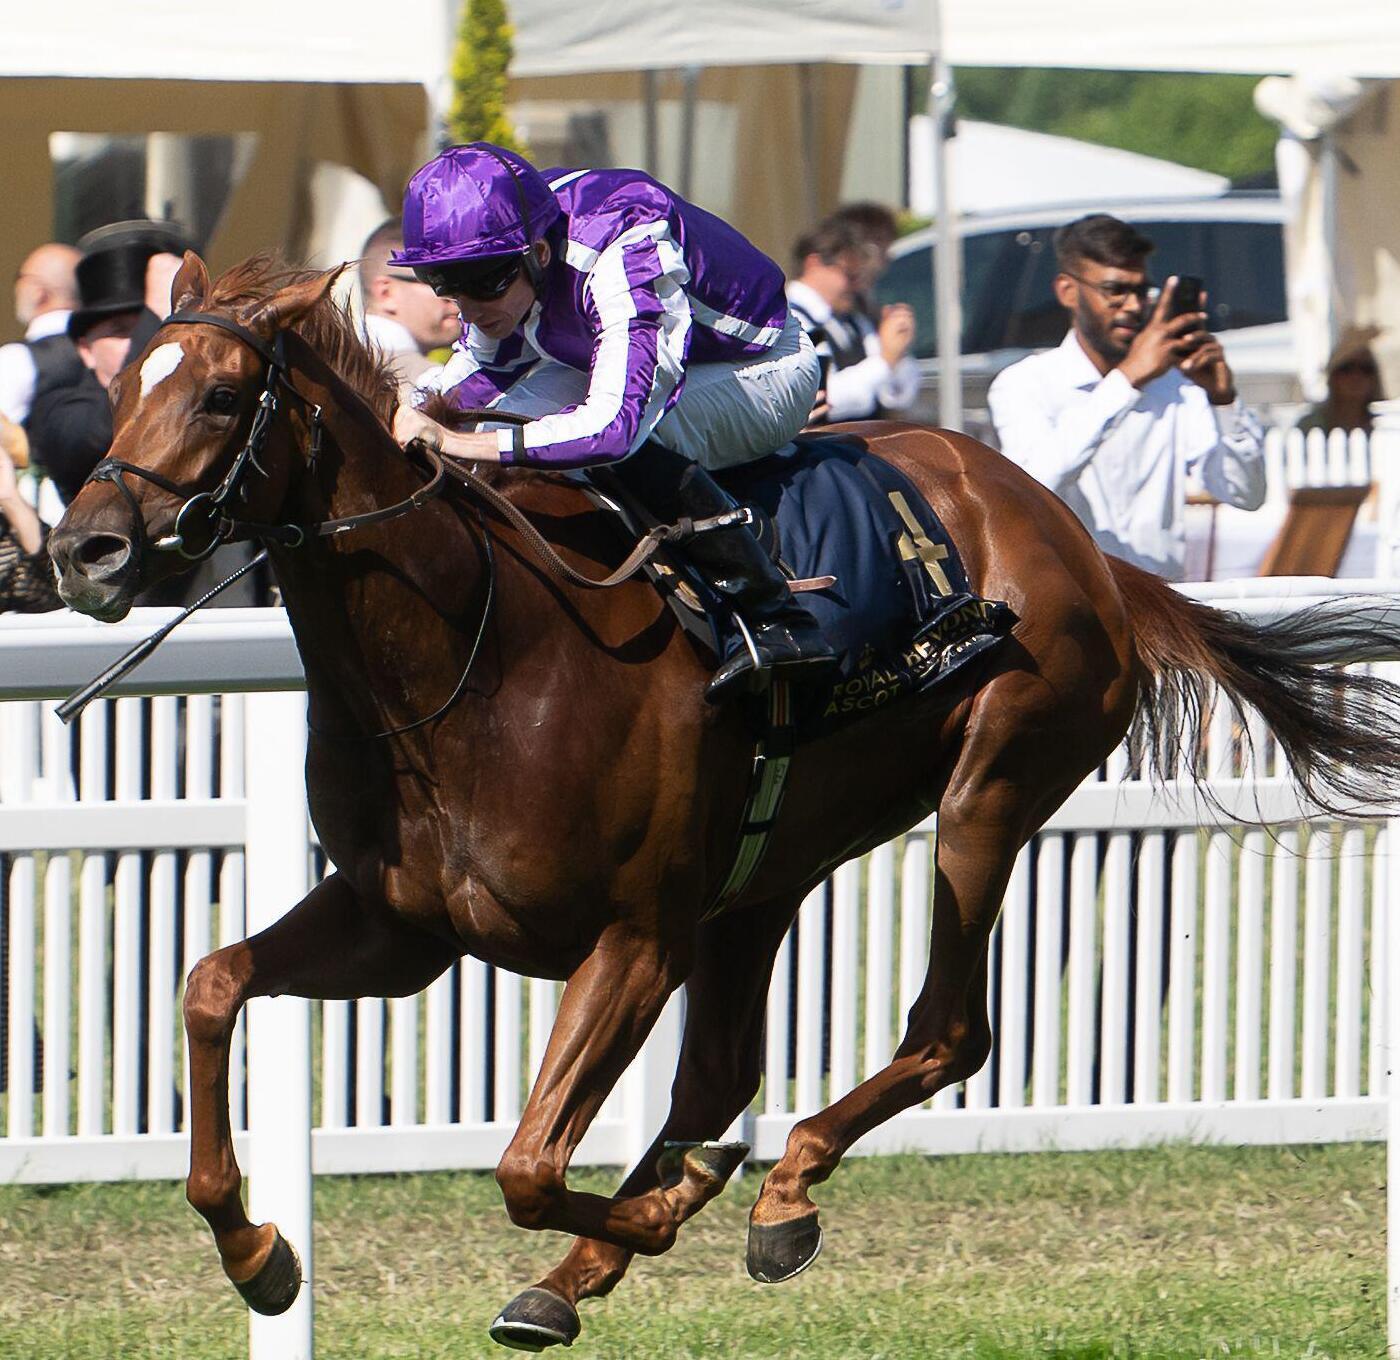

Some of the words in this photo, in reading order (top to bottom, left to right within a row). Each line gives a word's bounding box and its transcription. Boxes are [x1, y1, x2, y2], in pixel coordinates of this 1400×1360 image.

[888, 490, 953, 597] 4
[823, 682, 901, 718] ASCOT
[833, 669, 899, 698] ROYAL
